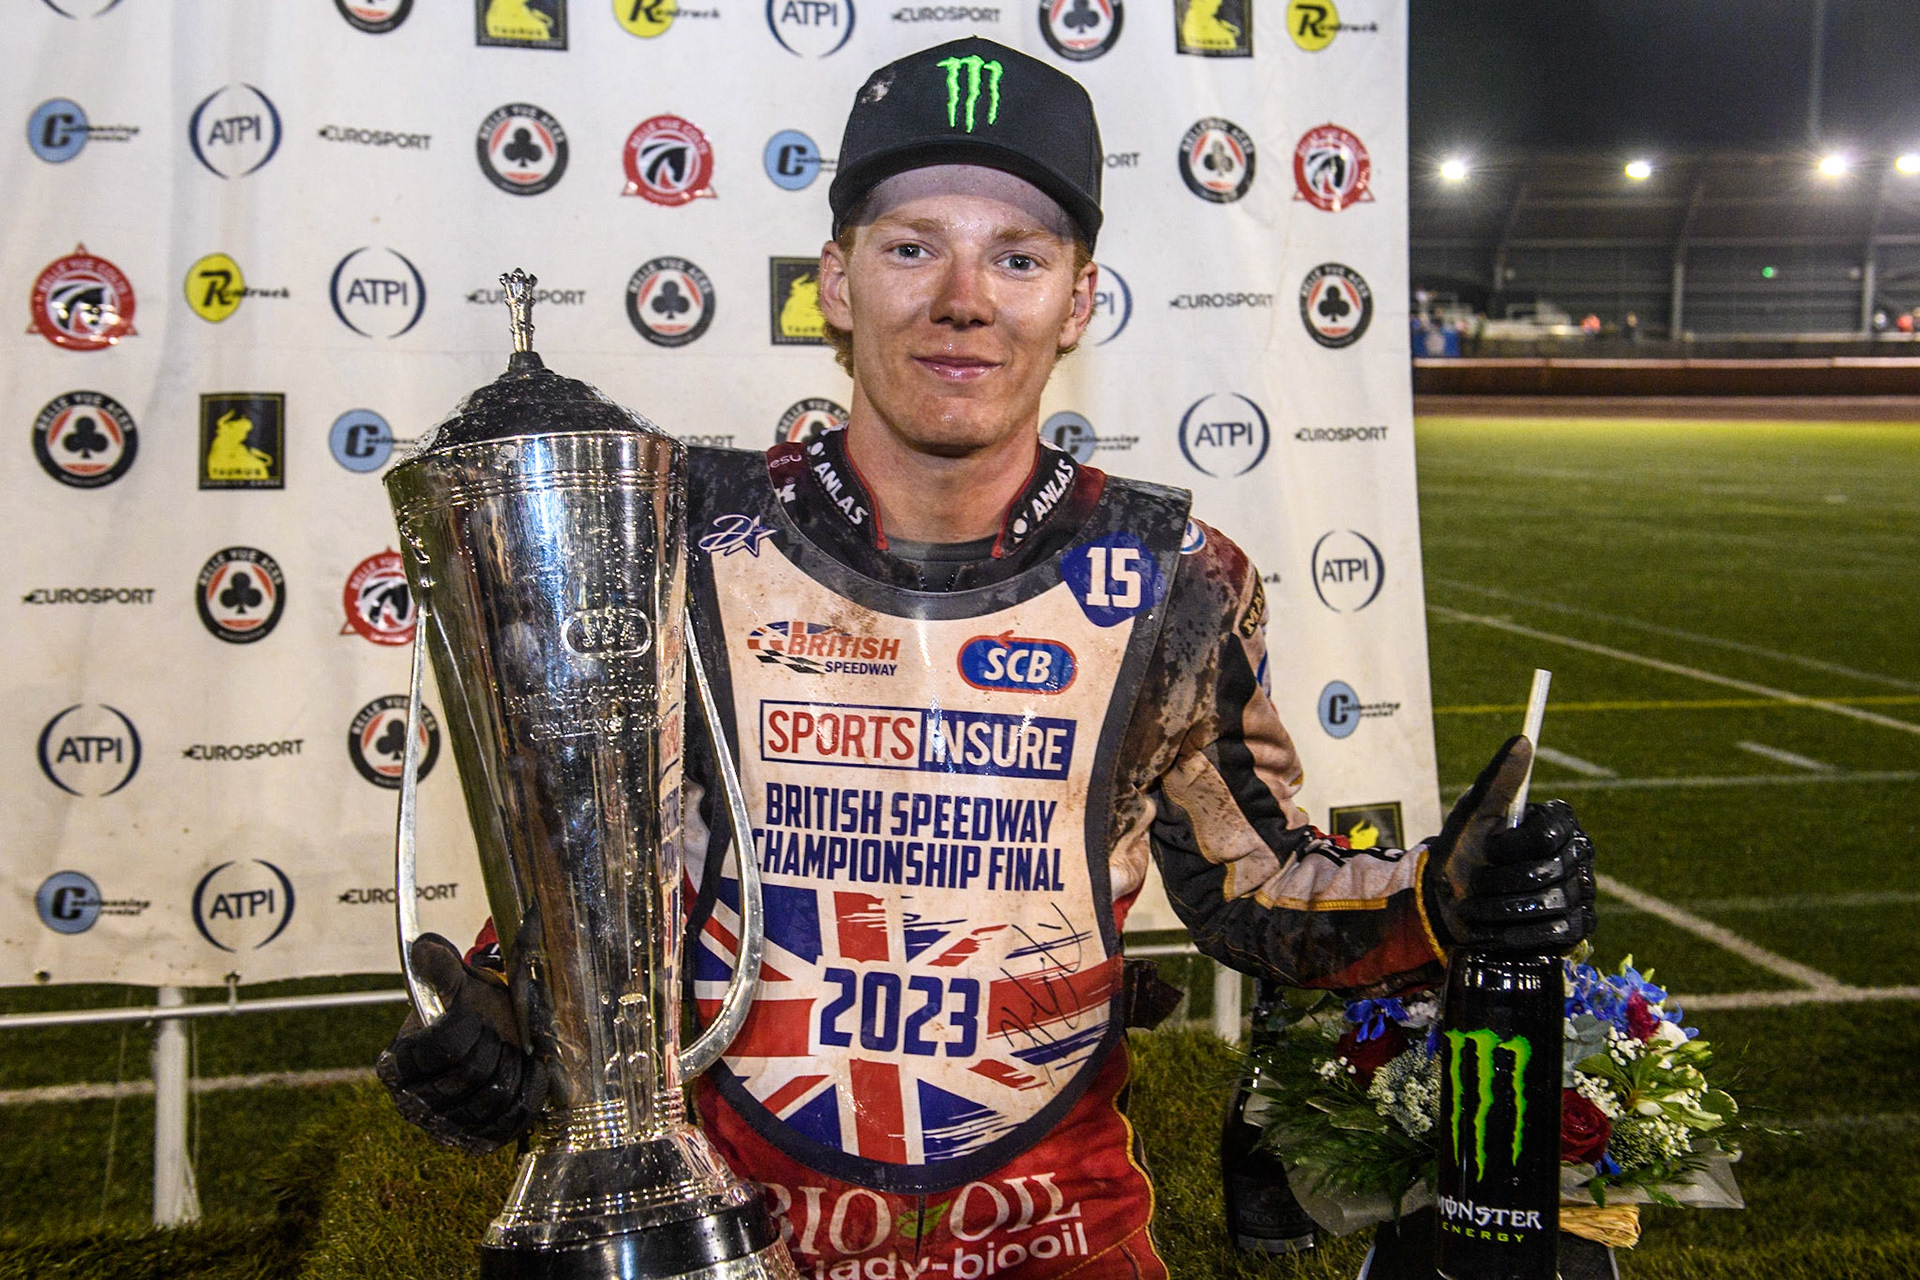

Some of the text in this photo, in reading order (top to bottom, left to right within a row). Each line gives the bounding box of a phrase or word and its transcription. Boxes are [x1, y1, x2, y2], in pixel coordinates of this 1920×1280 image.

[781, 0, 838, 26] ATPI
[891, 6, 1000, 22] EUROSPORT
[208, 115, 261, 145] ATPI
[318, 126, 431, 149] EUROSPORT
[346, 278, 408, 306] ATPI
[467, 288, 585, 305] EURPORT
[1169, 292, 1273, 310] EUROSPORT
[1195, 422, 1253, 447] ATPI
[1294, 426, 1388, 442] EUROSPORT
[813, 461, 870, 526] ANLAS
[1031, 458, 1075, 522] ANLAS
[1086, 547, 1141, 609] 15
[1321, 558, 1369, 583] ATPI
[23, 587, 155, 605] EUROSPORT
[787, 632, 901, 661] BRITISH
[825, 661, 898, 677] SPEEDWAY
[983, 647, 1053, 685] SCB
[56, 736, 123, 764] ATPI
[182, 739, 304, 761] EUROSPORT
[768, 709, 1070, 772] SPORTS INSURE
[766, 783, 1059, 844] BRITISH SPEEDWAY
[988, 845, 1065, 892] FINAL
[208, 888, 275, 920] ATPI
[338, 883, 458, 904] EUROPORT
[819, 967, 981, 1057] 2023
[950, 1171, 1082, 1243] OIL
[1437, 1194, 1543, 1231] MONSTER
[1442, 1221, 1525, 1243] ENERGY
